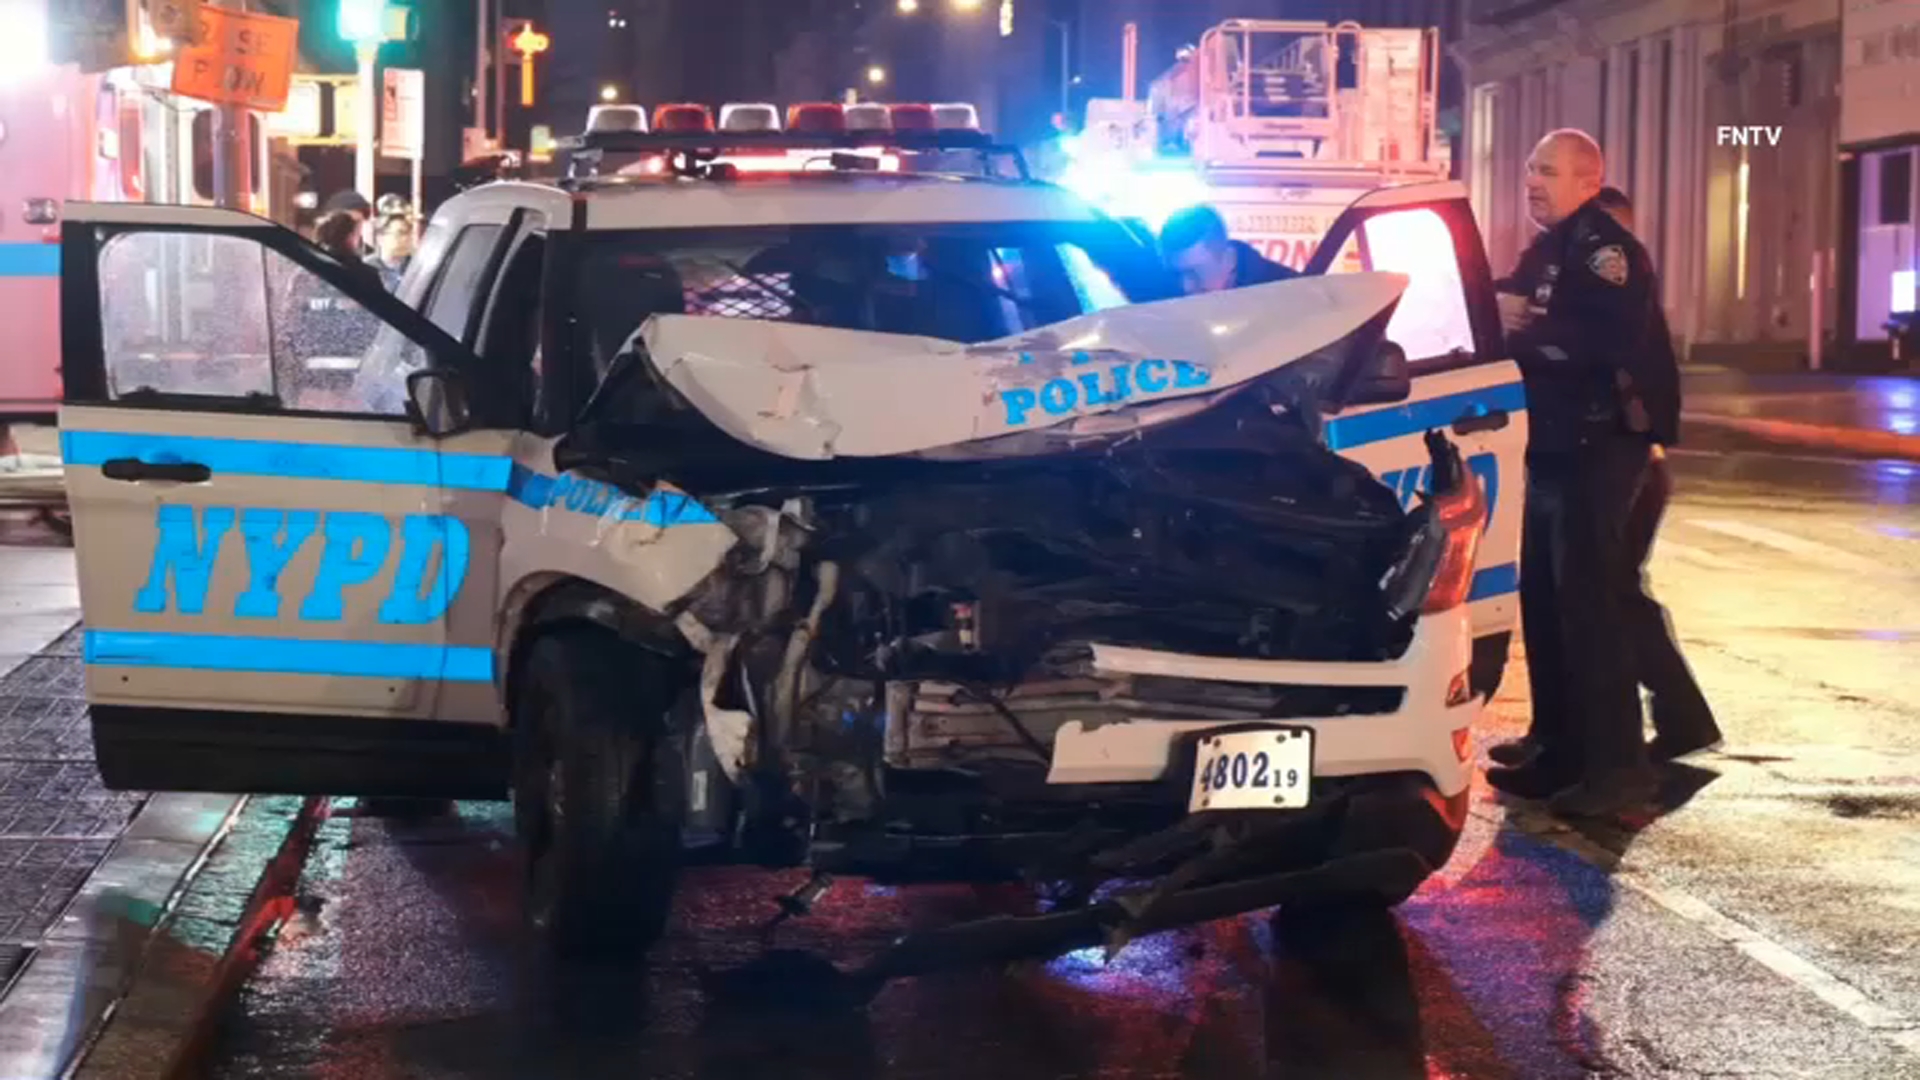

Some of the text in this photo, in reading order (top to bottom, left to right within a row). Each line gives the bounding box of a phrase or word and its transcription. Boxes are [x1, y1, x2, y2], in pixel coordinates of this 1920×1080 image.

[1001, 359, 1211, 425] POLICE
[133, 503, 470, 625] NYPD
[1201, 751, 1298, 792] 4802 19
